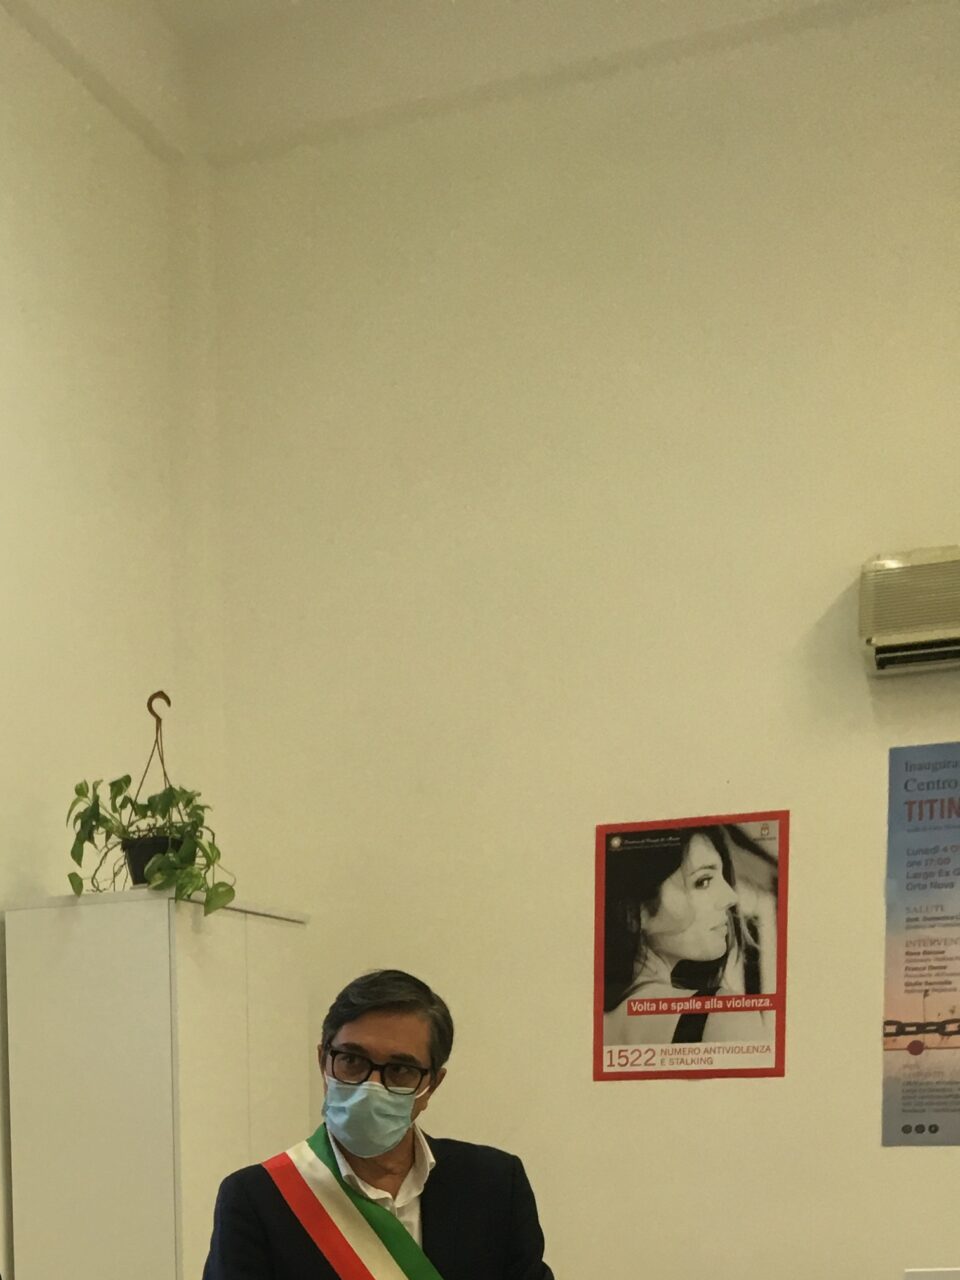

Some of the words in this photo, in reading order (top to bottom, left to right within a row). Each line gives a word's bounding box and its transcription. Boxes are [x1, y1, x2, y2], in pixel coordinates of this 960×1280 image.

[904, 760, 960, 773] Inaugura
[903, 778, 959, 792] Centro
[903, 796, 960, 823] TITIN
[905, 937, 960, 948] INTERVEN
[630, 1001, 656, 1012] Volta
[659, 1001, 668, 1010] le
[671, 1000, 701, 1012] spalle
[705, 999, 723, 1009] alla
[726, 997, 773, 1008] violenza.
[660, 1047, 701, 1056] NUMERO
[704, 1045, 772, 1055] ANTIVIOLENZA
[606, 1048, 656, 1068] 1522
[660, 1058, 666, 1066] E
[668, 1056, 714, 1066] STALKING
